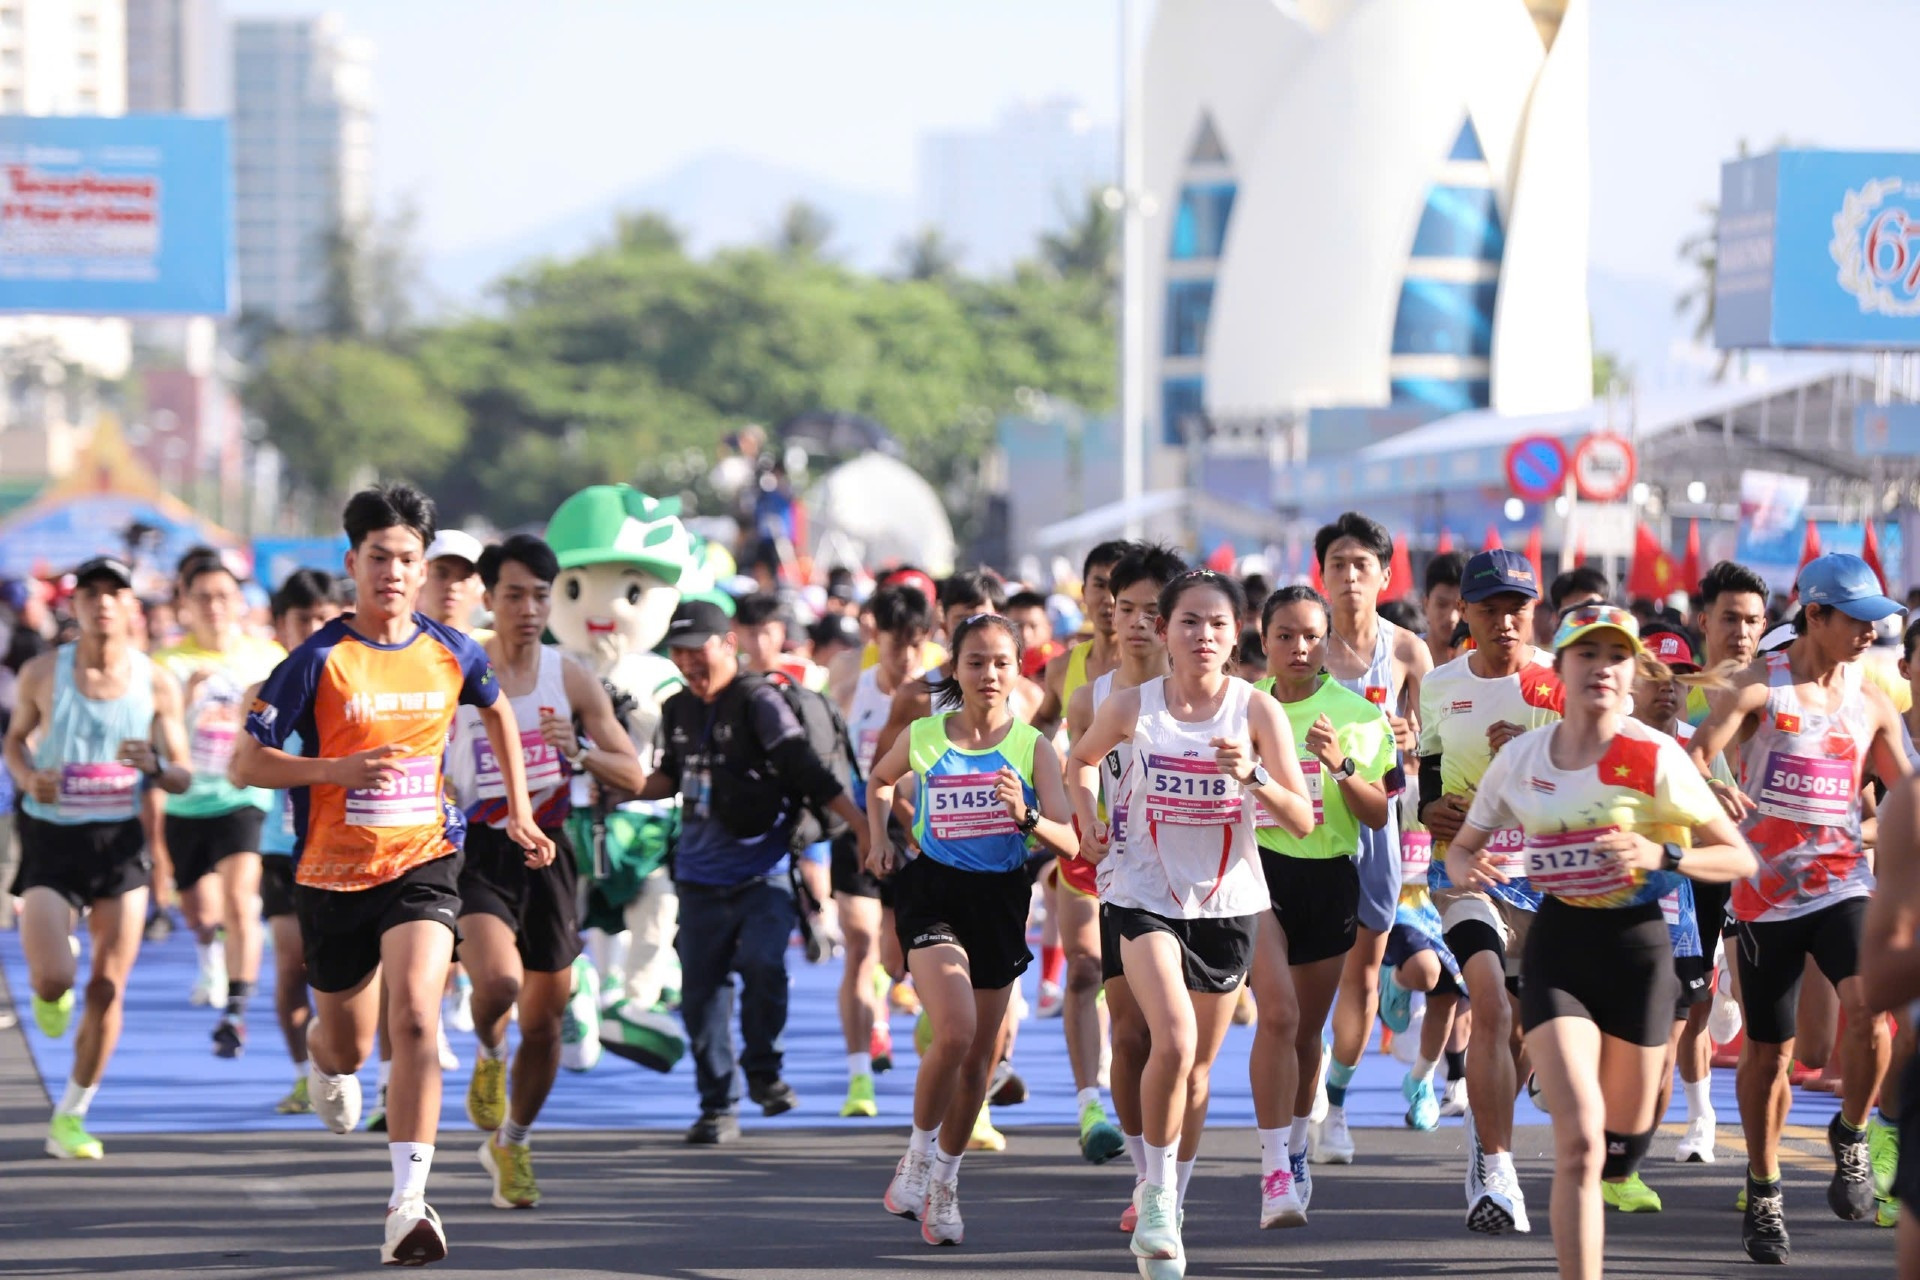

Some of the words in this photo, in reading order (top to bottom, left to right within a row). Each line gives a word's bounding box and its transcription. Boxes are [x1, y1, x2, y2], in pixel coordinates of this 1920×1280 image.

[1155, 774, 1226, 796] 52118
[1770, 769, 1838, 796] 50505
[936, 790, 1001, 810] 51459
